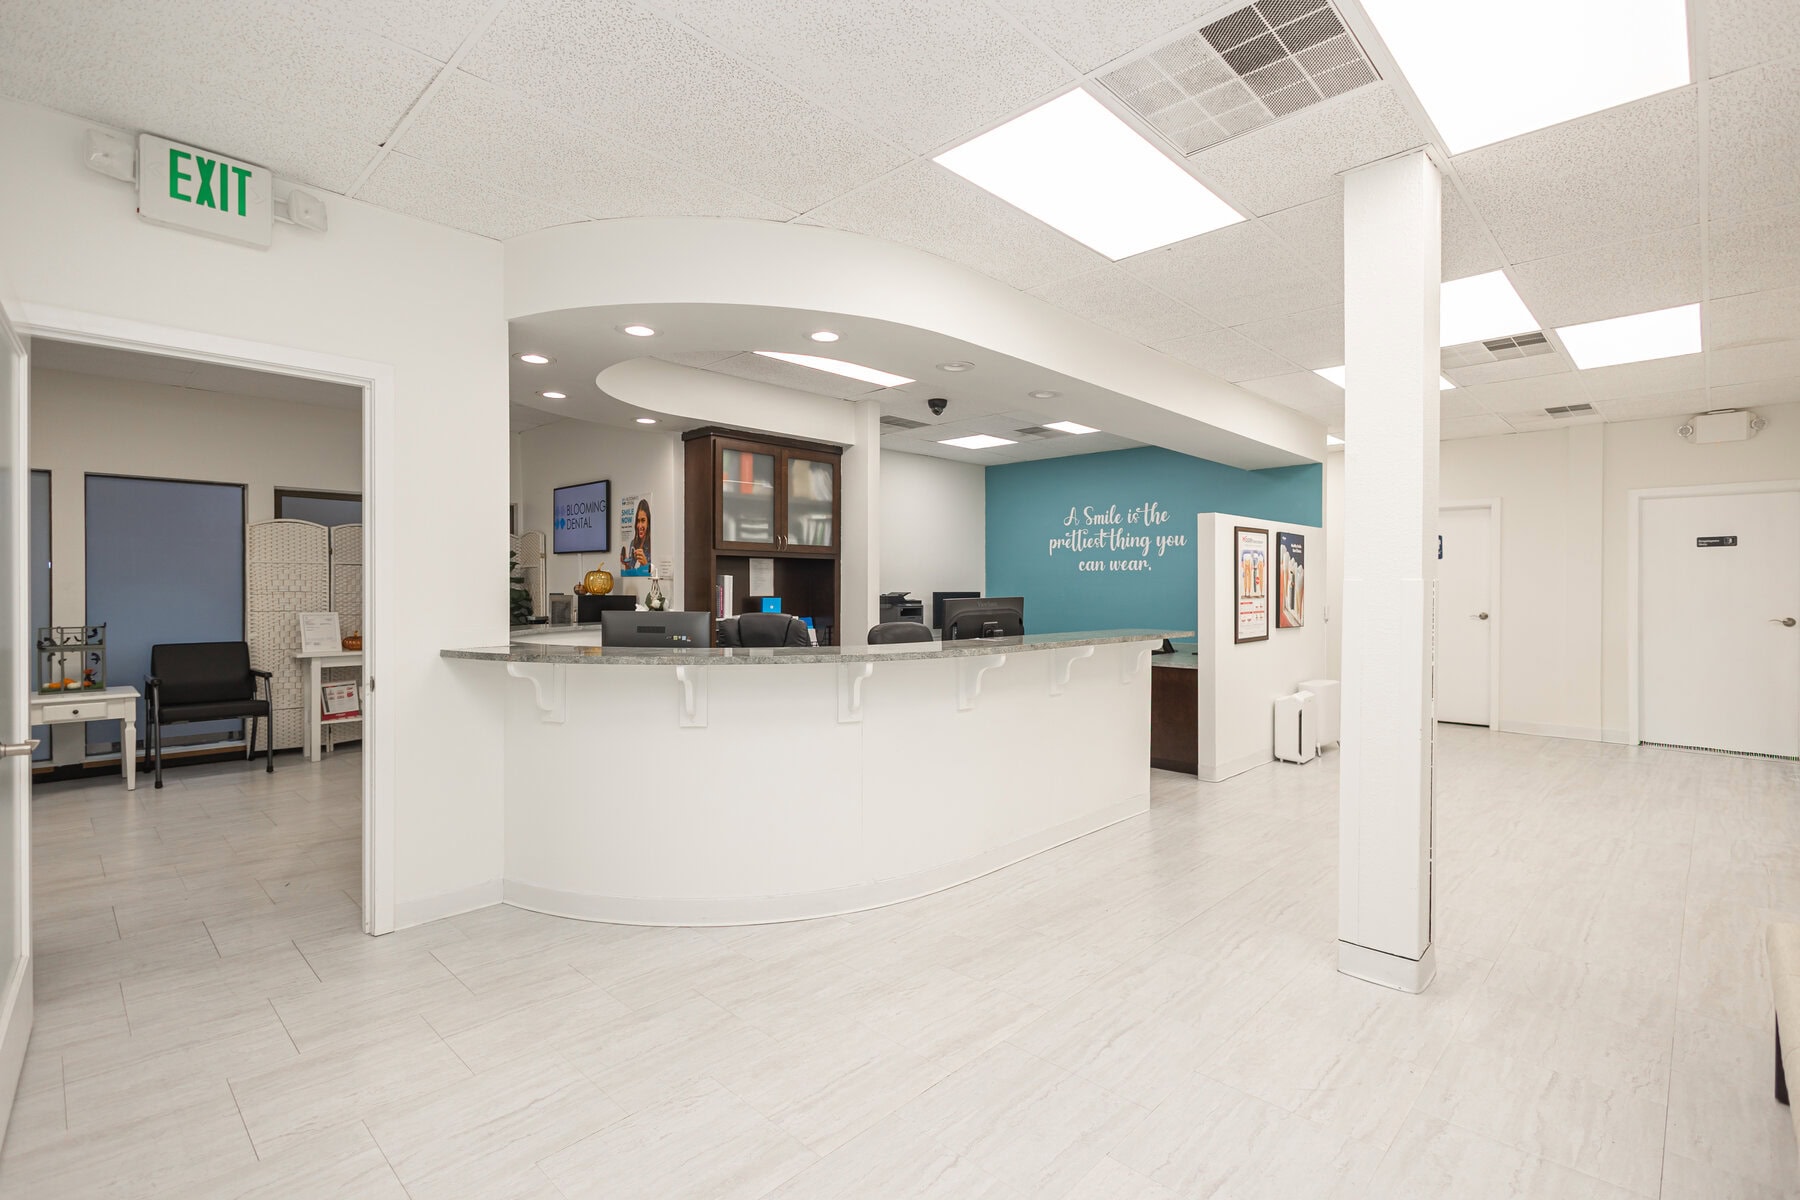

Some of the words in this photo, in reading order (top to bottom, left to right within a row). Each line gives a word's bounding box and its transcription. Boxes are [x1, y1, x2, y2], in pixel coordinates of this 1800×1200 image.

[169, 148, 252, 217] EXIT
[566, 500, 606, 516] BLOOMING
[1063, 506, 1080, 526] A
[1083, 504, 1123, 526] Smile
[1127, 509, 1140, 524] is
[1136, 501, 1170, 527] the
[566, 517, 592, 530] DENTAL
[1049, 528, 1107, 556] prettiest
[1105, 527, 1152, 557] thing
[1156, 534, 1188, 557] you
[1078, 560, 1106, 572] can
[1109, 559, 1152, 572] wear.
